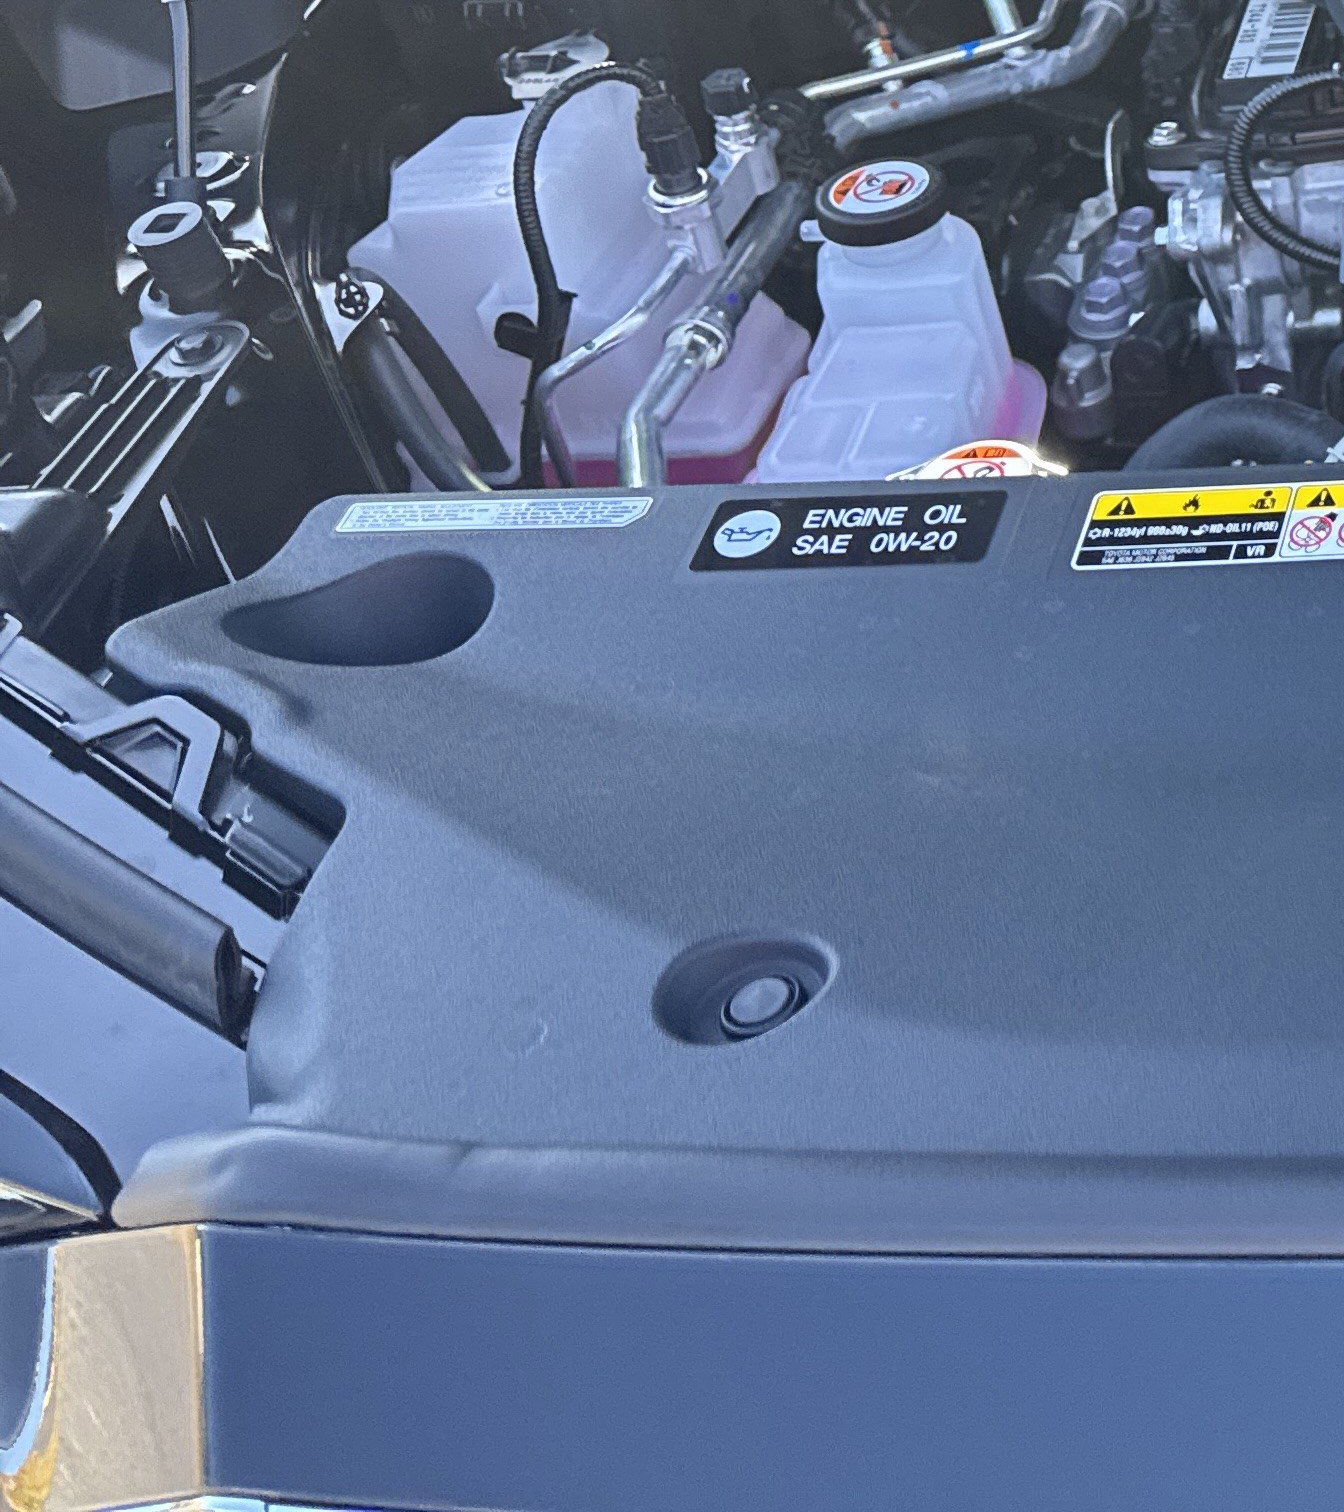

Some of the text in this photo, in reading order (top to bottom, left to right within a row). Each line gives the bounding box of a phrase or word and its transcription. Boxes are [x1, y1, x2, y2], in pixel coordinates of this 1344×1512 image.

[802, 504, 967, 529] ENGINE OIL
[791, 530, 958, 556] SAE 0W-20
[1246, 544, 1266, 558] VR
